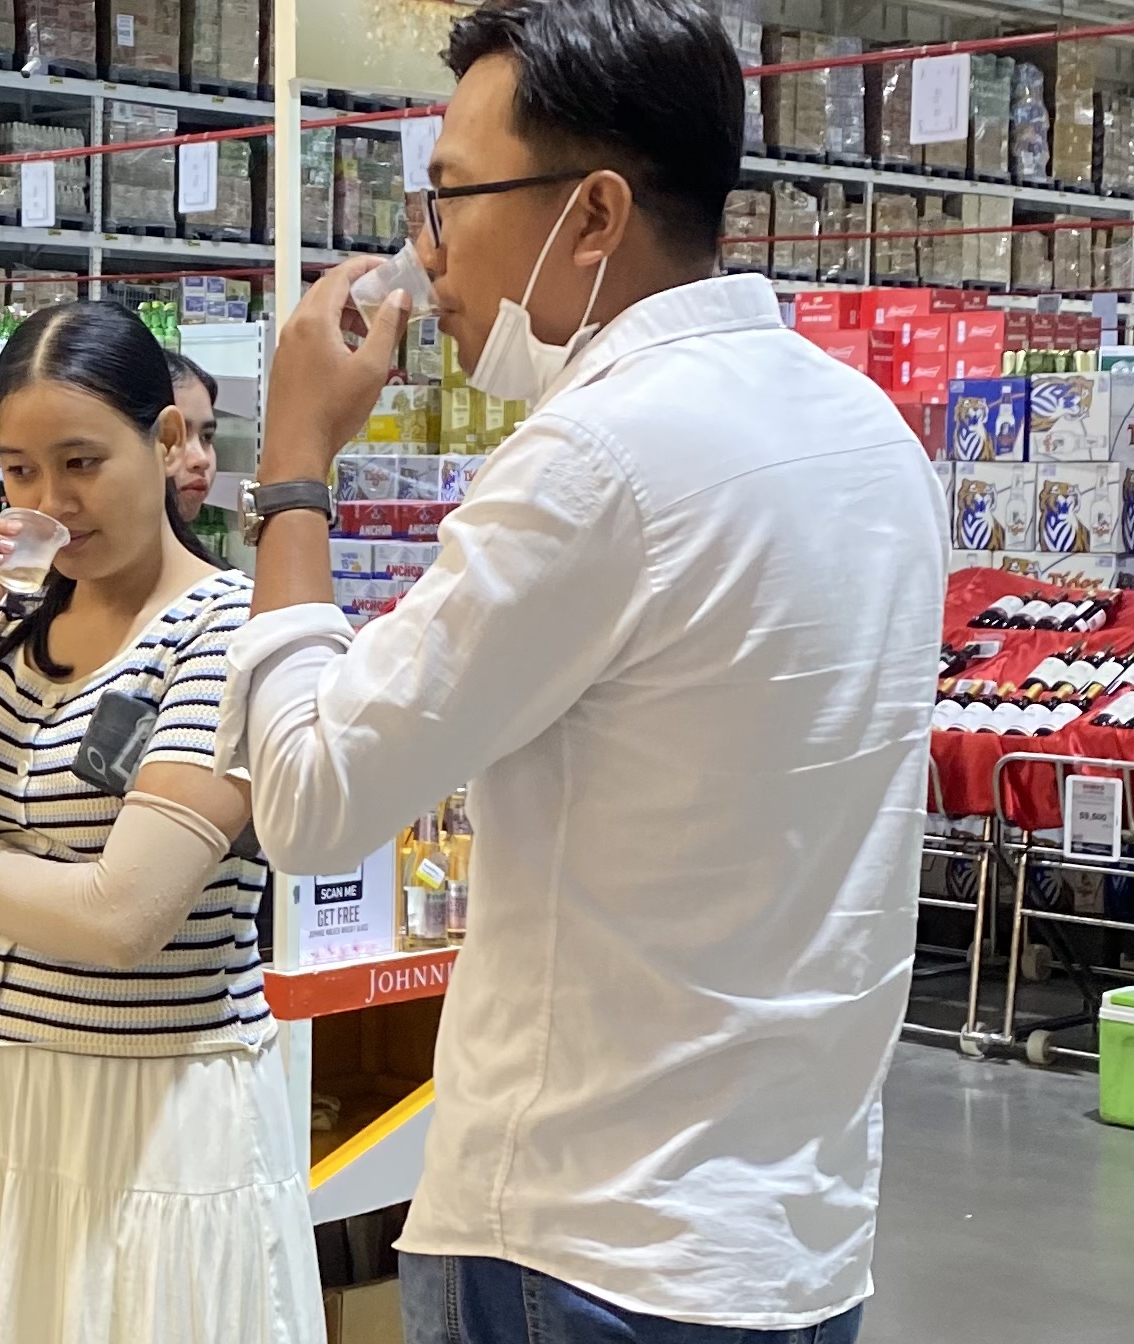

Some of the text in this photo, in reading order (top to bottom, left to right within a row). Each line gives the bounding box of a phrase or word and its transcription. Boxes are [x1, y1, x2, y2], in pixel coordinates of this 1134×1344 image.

[352, 598, 388, 611] ANCHO
[321, 884, 357, 900] SCAN ME
[317, 905, 361, 927] GET FREE
[365, 961, 453, 1004] JOHNNI
